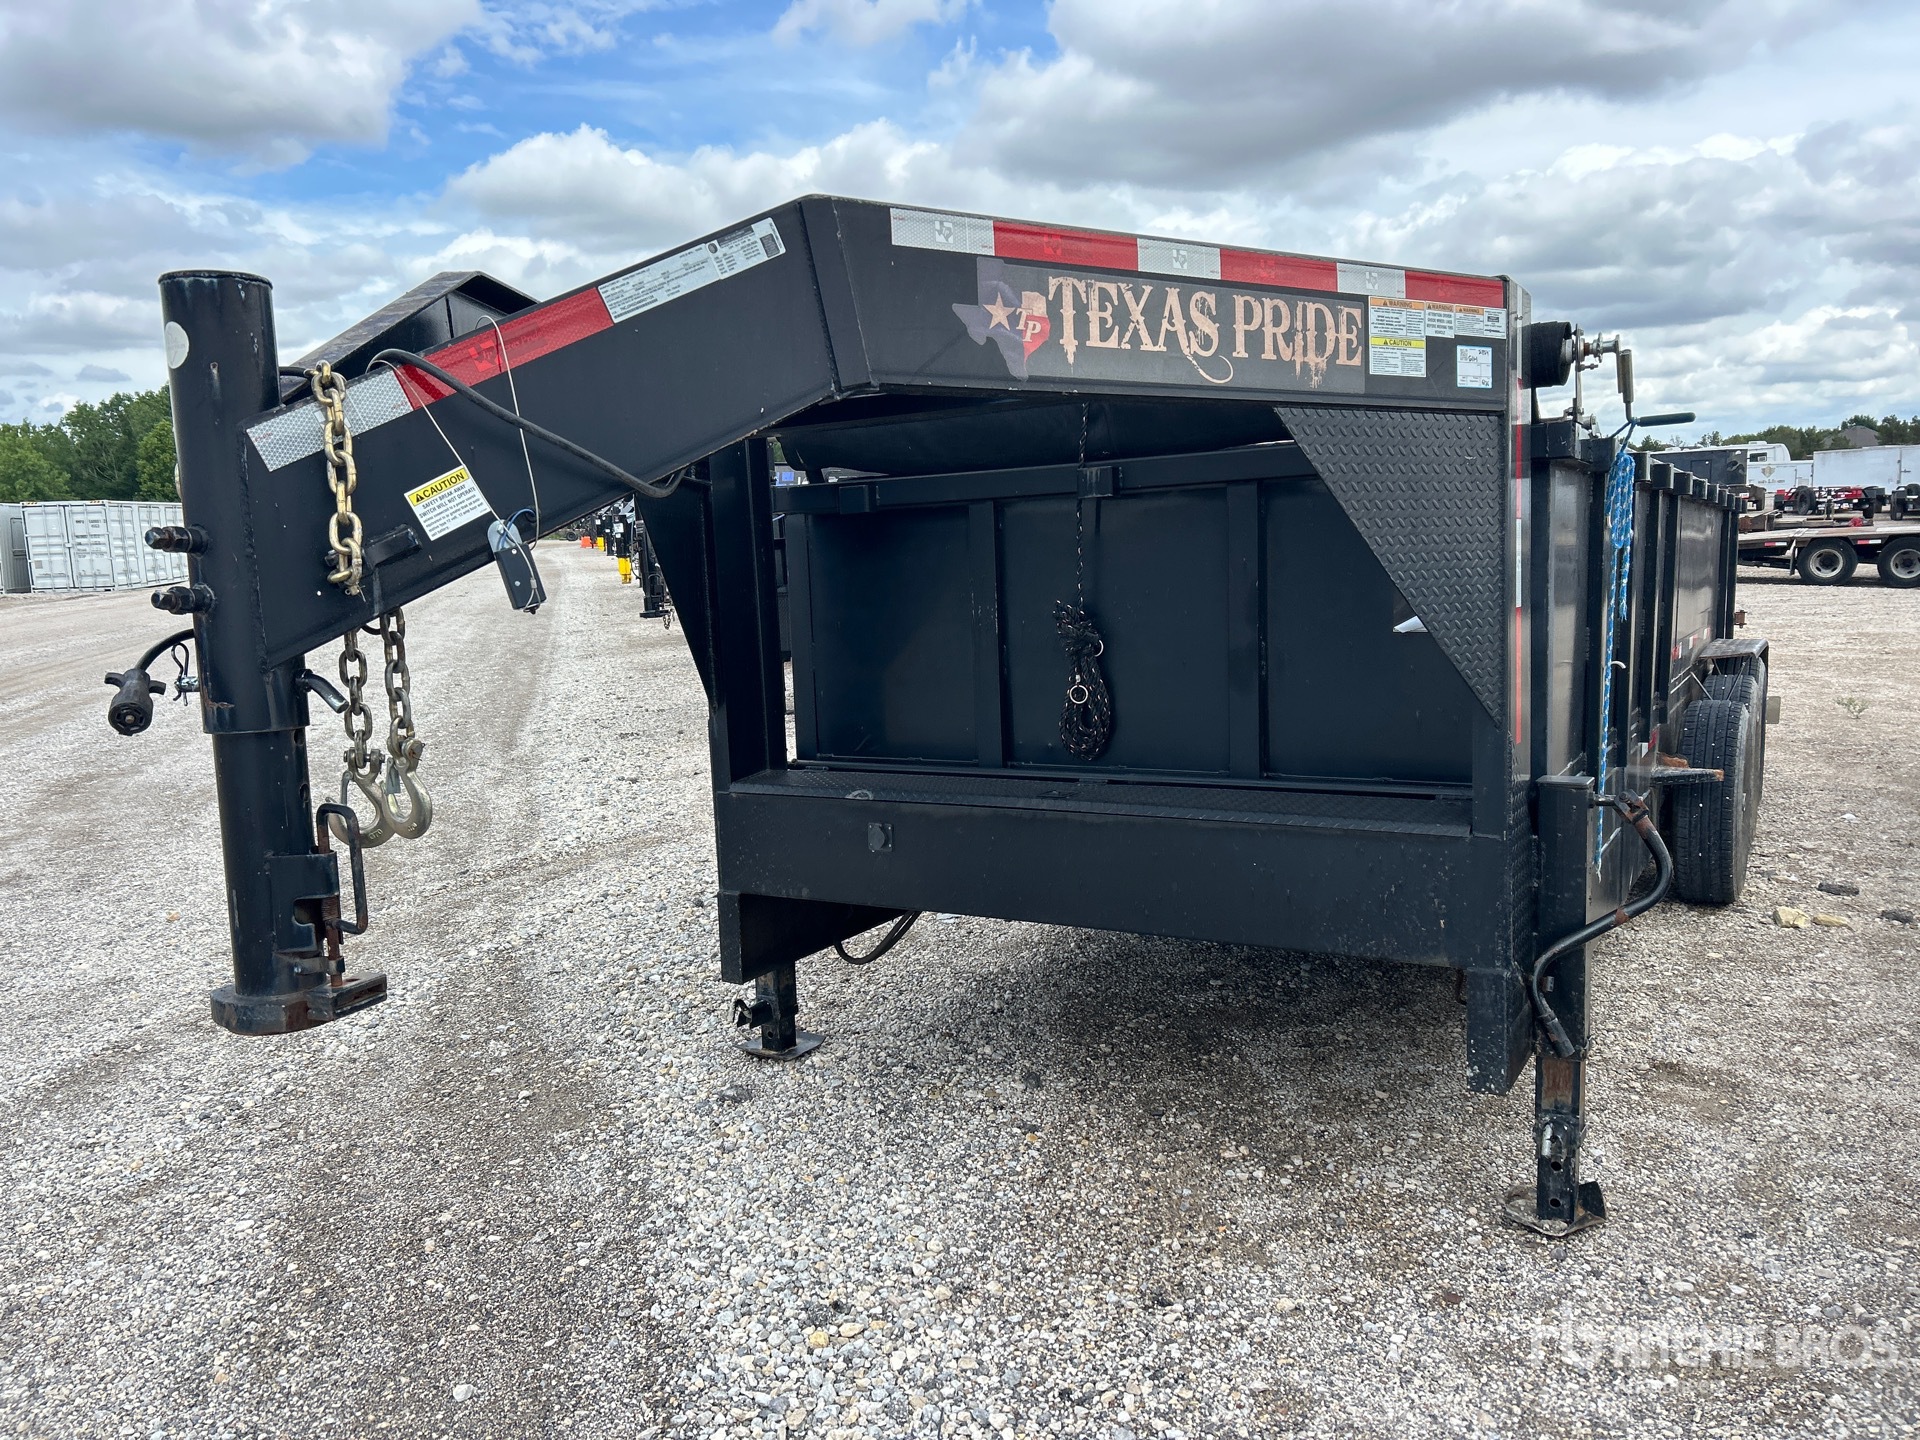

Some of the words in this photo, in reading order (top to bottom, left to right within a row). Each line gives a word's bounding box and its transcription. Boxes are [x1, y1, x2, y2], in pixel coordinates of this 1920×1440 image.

[1388, 300, 1412, 309] WARNING
[1432, 303, 1453, 312] WARNING
[1015, 306, 1043, 344] TP
[1048, 275, 1233, 384] TEXAS
[1231, 293, 1363, 386] PRIDE
[1389, 339, 1412, 347] CAUTION
[423, 472, 465, 498] CAUTION
[419, 506, 437, 518] SWITCH
[437, 501, 447, 509] WILL
[457, 487, 476, 499] OPERATE
[422, 498, 439, 509] SAFETY
